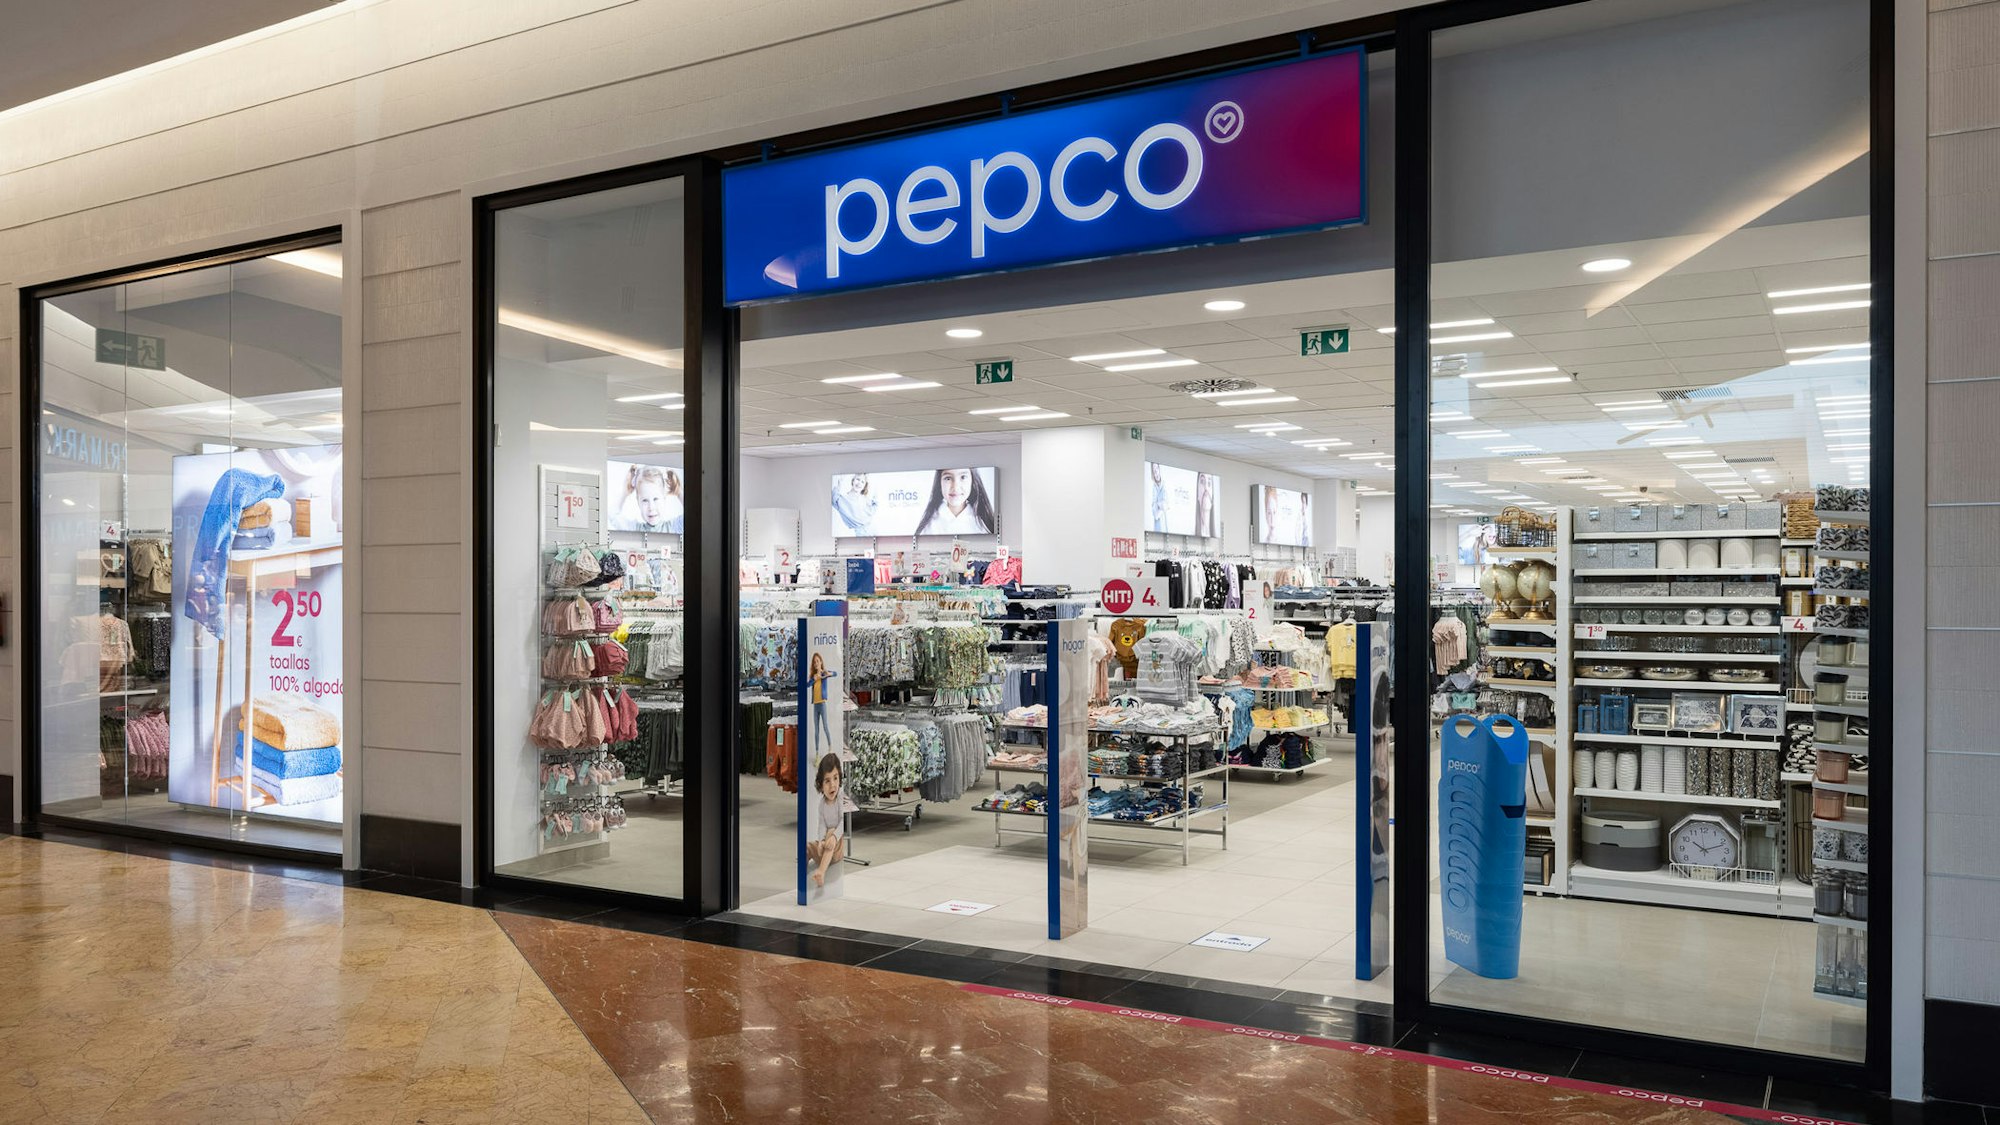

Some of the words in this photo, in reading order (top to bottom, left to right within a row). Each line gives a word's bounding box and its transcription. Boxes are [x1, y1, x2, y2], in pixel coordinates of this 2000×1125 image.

[825, 122, 1204, 279] pepco
[888, 489, 918, 501] niñas
[781, 551, 790, 566] 2
[1103, 589, 1132, 604] HIT!
[1142, 587, 1157, 607] 4
[1248, 607, 1256, 619] 2
[814, 633, 838, 646] niños
[1062, 638, 1085, 655] hogar
[269, 653, 310, 670] toallas
[269, 675, 300, 692] 100%
[1448, 760, 1479, 774] pepco
